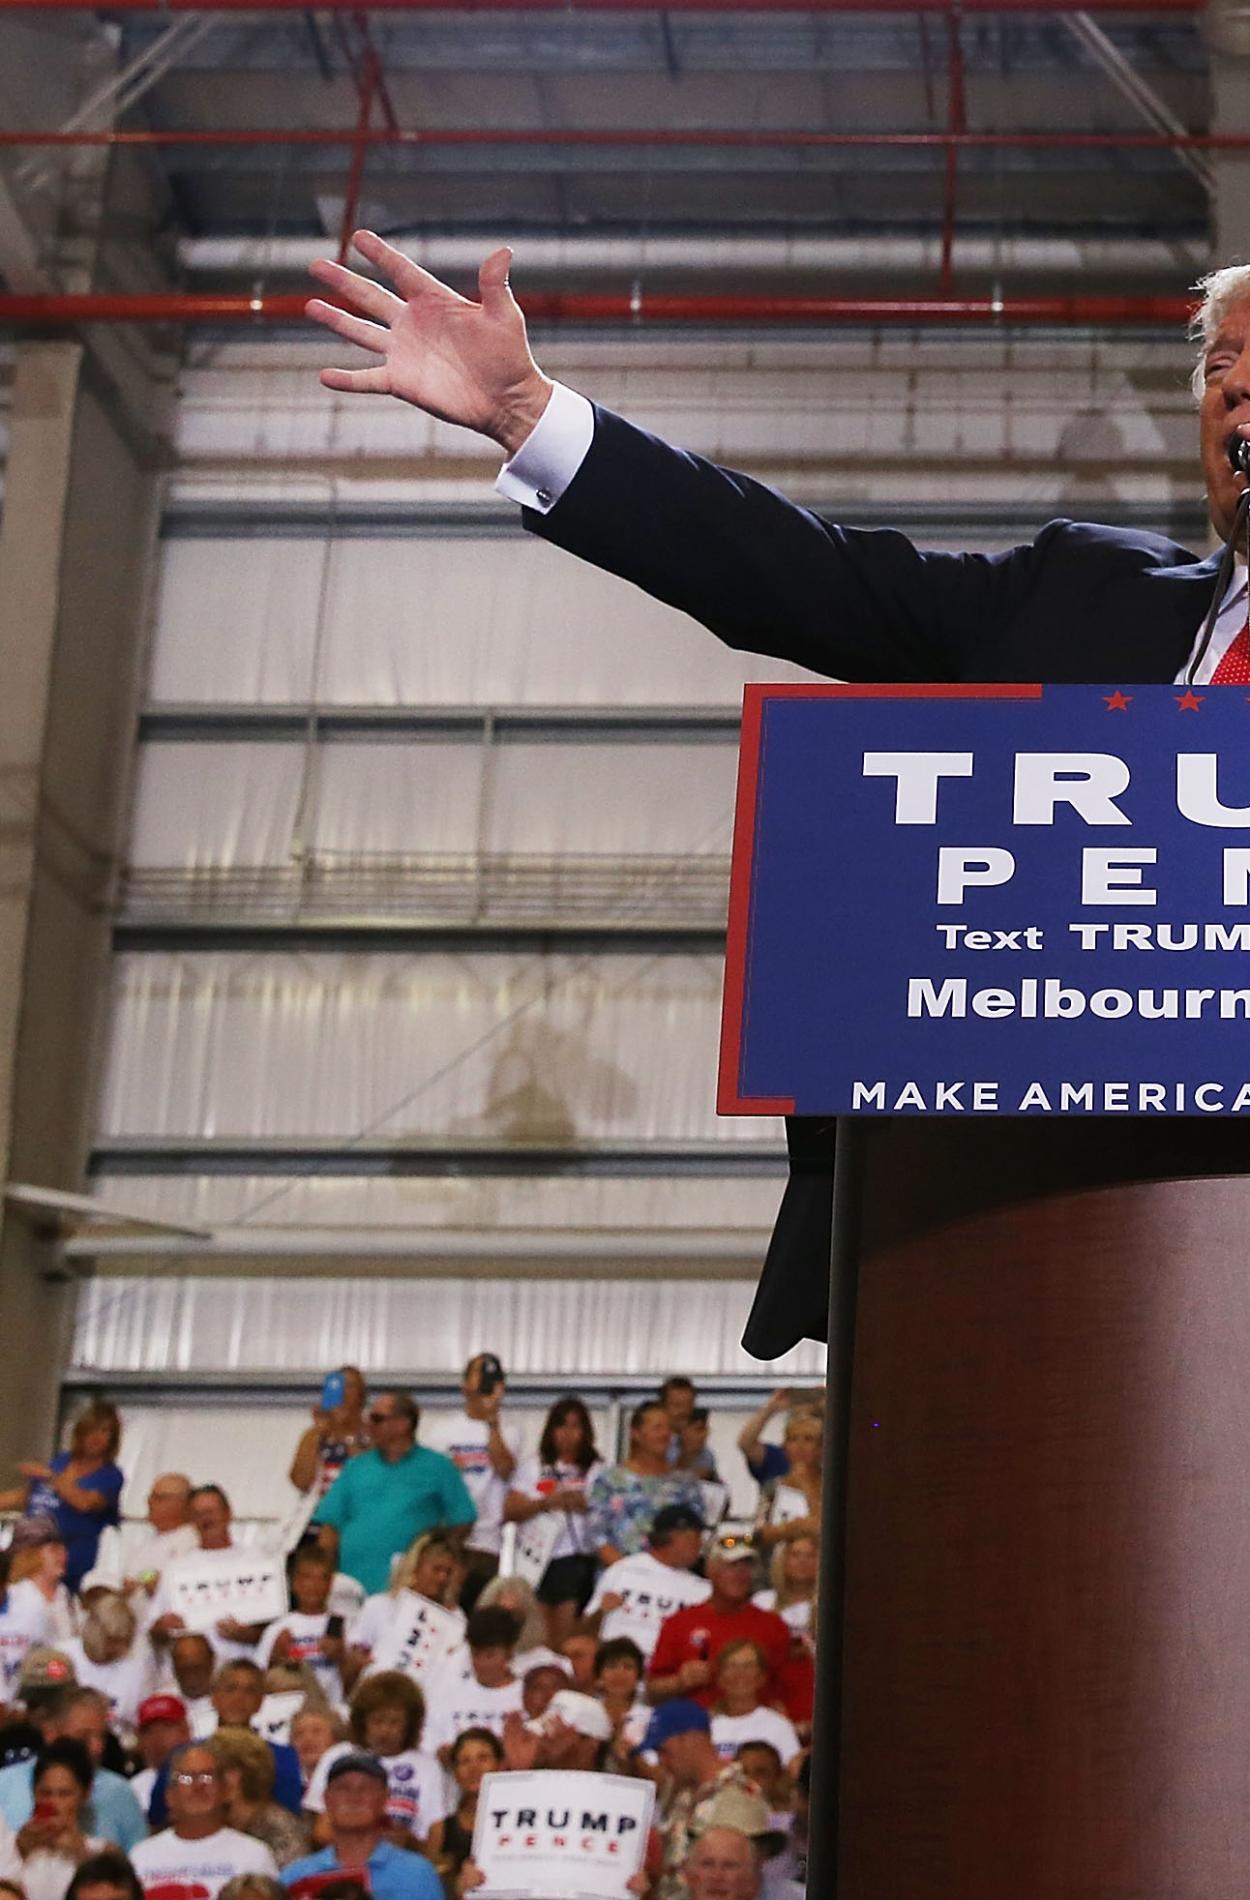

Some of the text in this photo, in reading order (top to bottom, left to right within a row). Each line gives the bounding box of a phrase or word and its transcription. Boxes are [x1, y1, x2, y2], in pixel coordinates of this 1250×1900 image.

[937, 924, 1044, 951] Text
[852, 1081, 1000, 1112] MAKE
[491, 1808, 637, 1834] TRUMP
